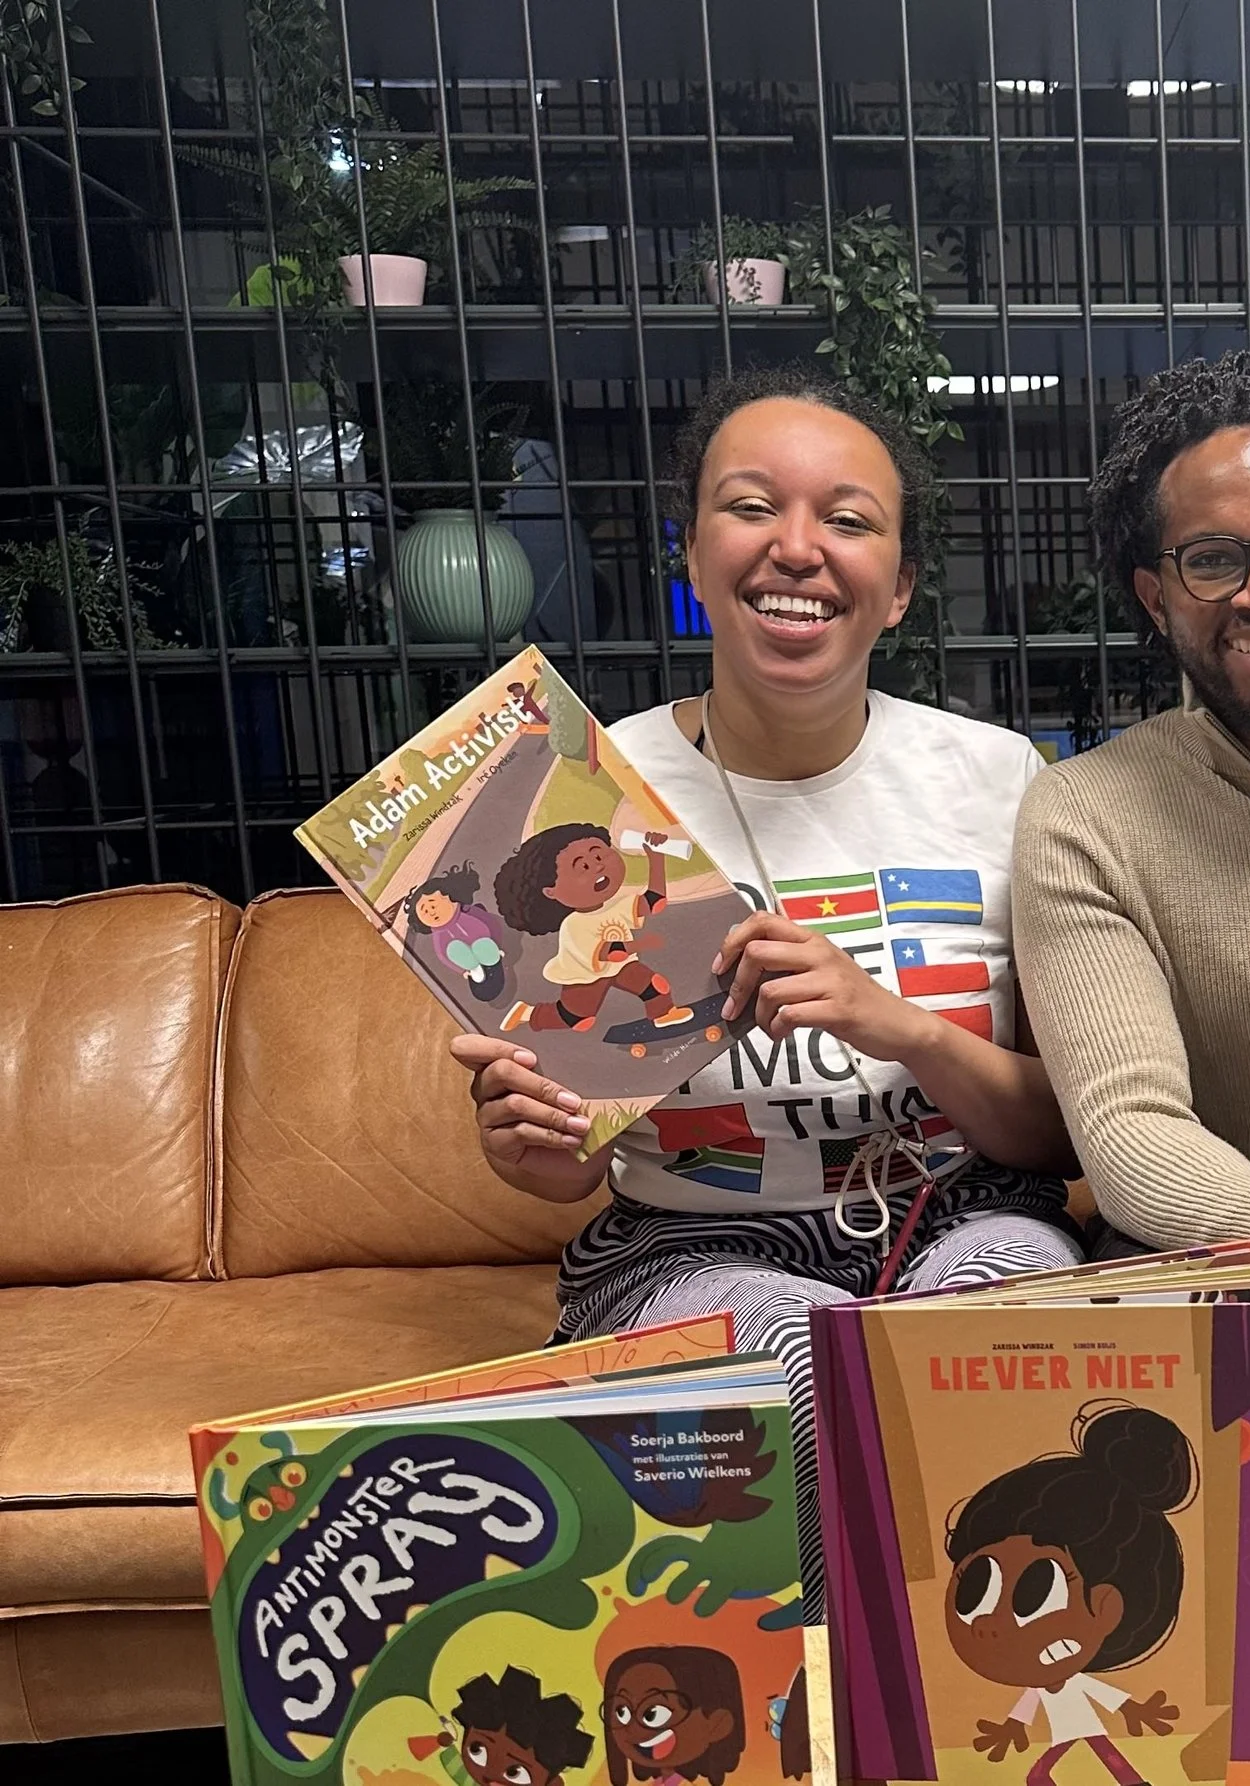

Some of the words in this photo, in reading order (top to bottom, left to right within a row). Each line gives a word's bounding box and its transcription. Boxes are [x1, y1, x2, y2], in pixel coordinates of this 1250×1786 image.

[349, 783, 428, 849] Adam
[423, 696, 533, 791] Activist
[403, 816, 432, 841] Zarissa
[929, 1355, 1072, 1391] LIEVER
[1087, 1354, 1181, 1390] NIET
[631, 1433, 675, 1448] Soerja
[678, 1429, 744, 1444] Bakboord
[632, 1455, 653, 1464] met
[655, 1452, 708, 1463] illustraties
[711, 1452, 728, 1460] van
[634, 1468, 686, 1482] Saverio
[688, 1466, 751, 1480] Wielkens
